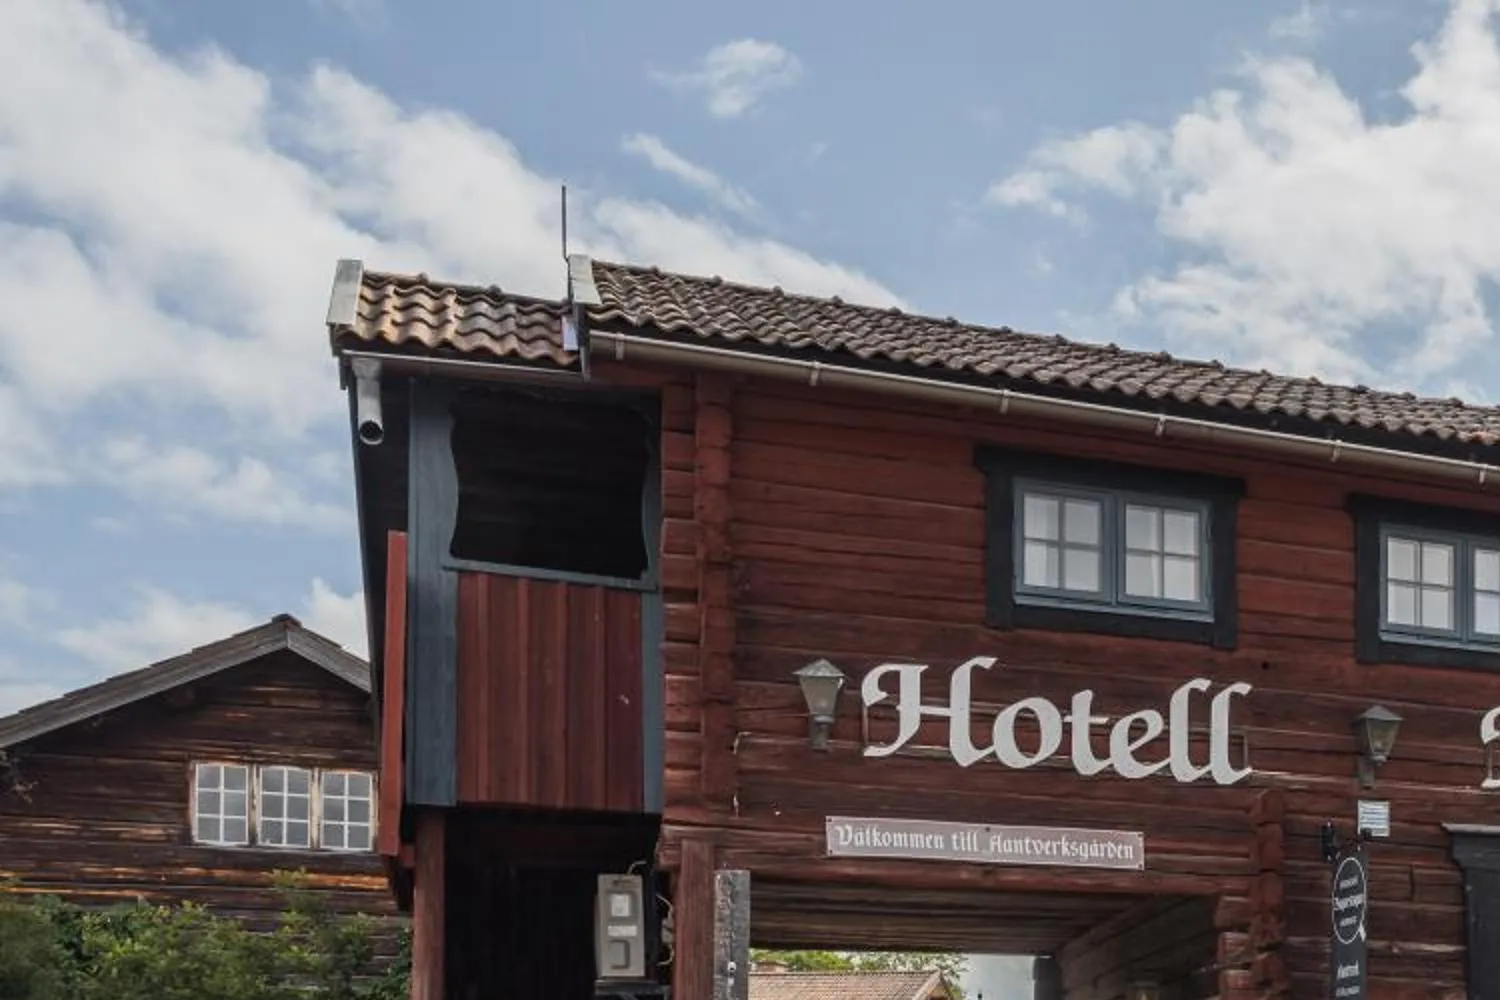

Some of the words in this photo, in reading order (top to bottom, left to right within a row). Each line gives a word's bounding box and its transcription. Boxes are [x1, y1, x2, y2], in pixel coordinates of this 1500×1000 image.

[861, 656, 1253, 785] Hotell
[834, 823, 945, 850] Välkommen
[952, 831, 979, 853] till
